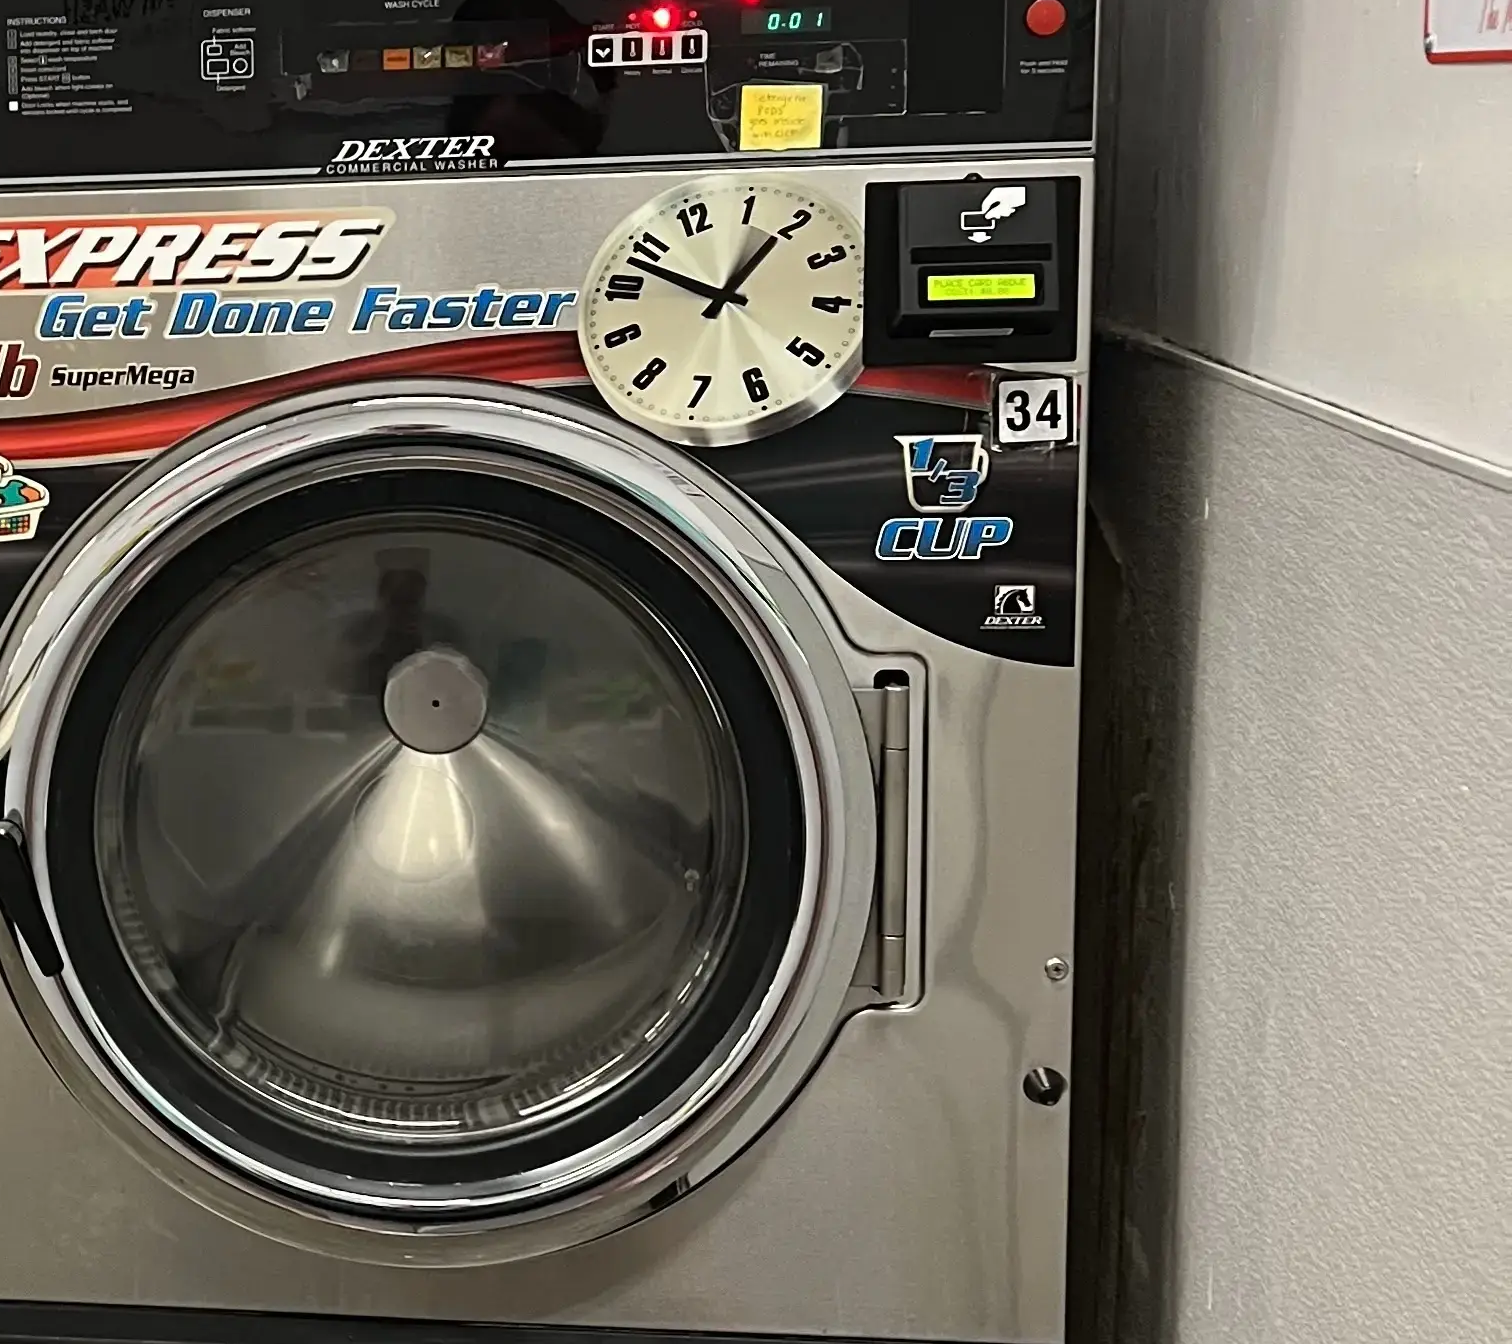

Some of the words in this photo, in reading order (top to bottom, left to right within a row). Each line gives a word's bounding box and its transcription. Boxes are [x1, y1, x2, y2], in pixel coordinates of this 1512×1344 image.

[202, 7, 251, 17] DISPENSER
[385, 0, 413, 9] WASH
[414, 0, 441, 8] CYCLE
[6, 16, 67, 25] INSTRUCTIONS
[330, 135, 495, 162] DEXTER
[326, 161, 427, 175] COMMERCIAL
[434, 159, 498, 171] WASHER
[676, 202, 713, 238] 12
[741, 195, 756, 225] 1
[776, 209, 812, 240] 2
[632, 231, 670, 263] 11
[806, 245, 847, 270] 3
[604, 274, 644, 302] 10
[37, 292, 153, 341] Get
[165, 289, 332, 340] Done
[347, 284, 579, 335] Faster
[811, 295, 852, 314] 4
[604, 323, 642, 348] 9
[785, 336, 825, 367] 5
[50, 364, 196, 390] SuperMega
[632, 357, 667, 391] 8
[742, 367, 770, 403] 6
[687, 375, 712, 408] 7
[1005, 389, 1062, 432] 34
[875, 517, 1014, 560] CUP
[983, 616, 1043, 625] DEXTER
